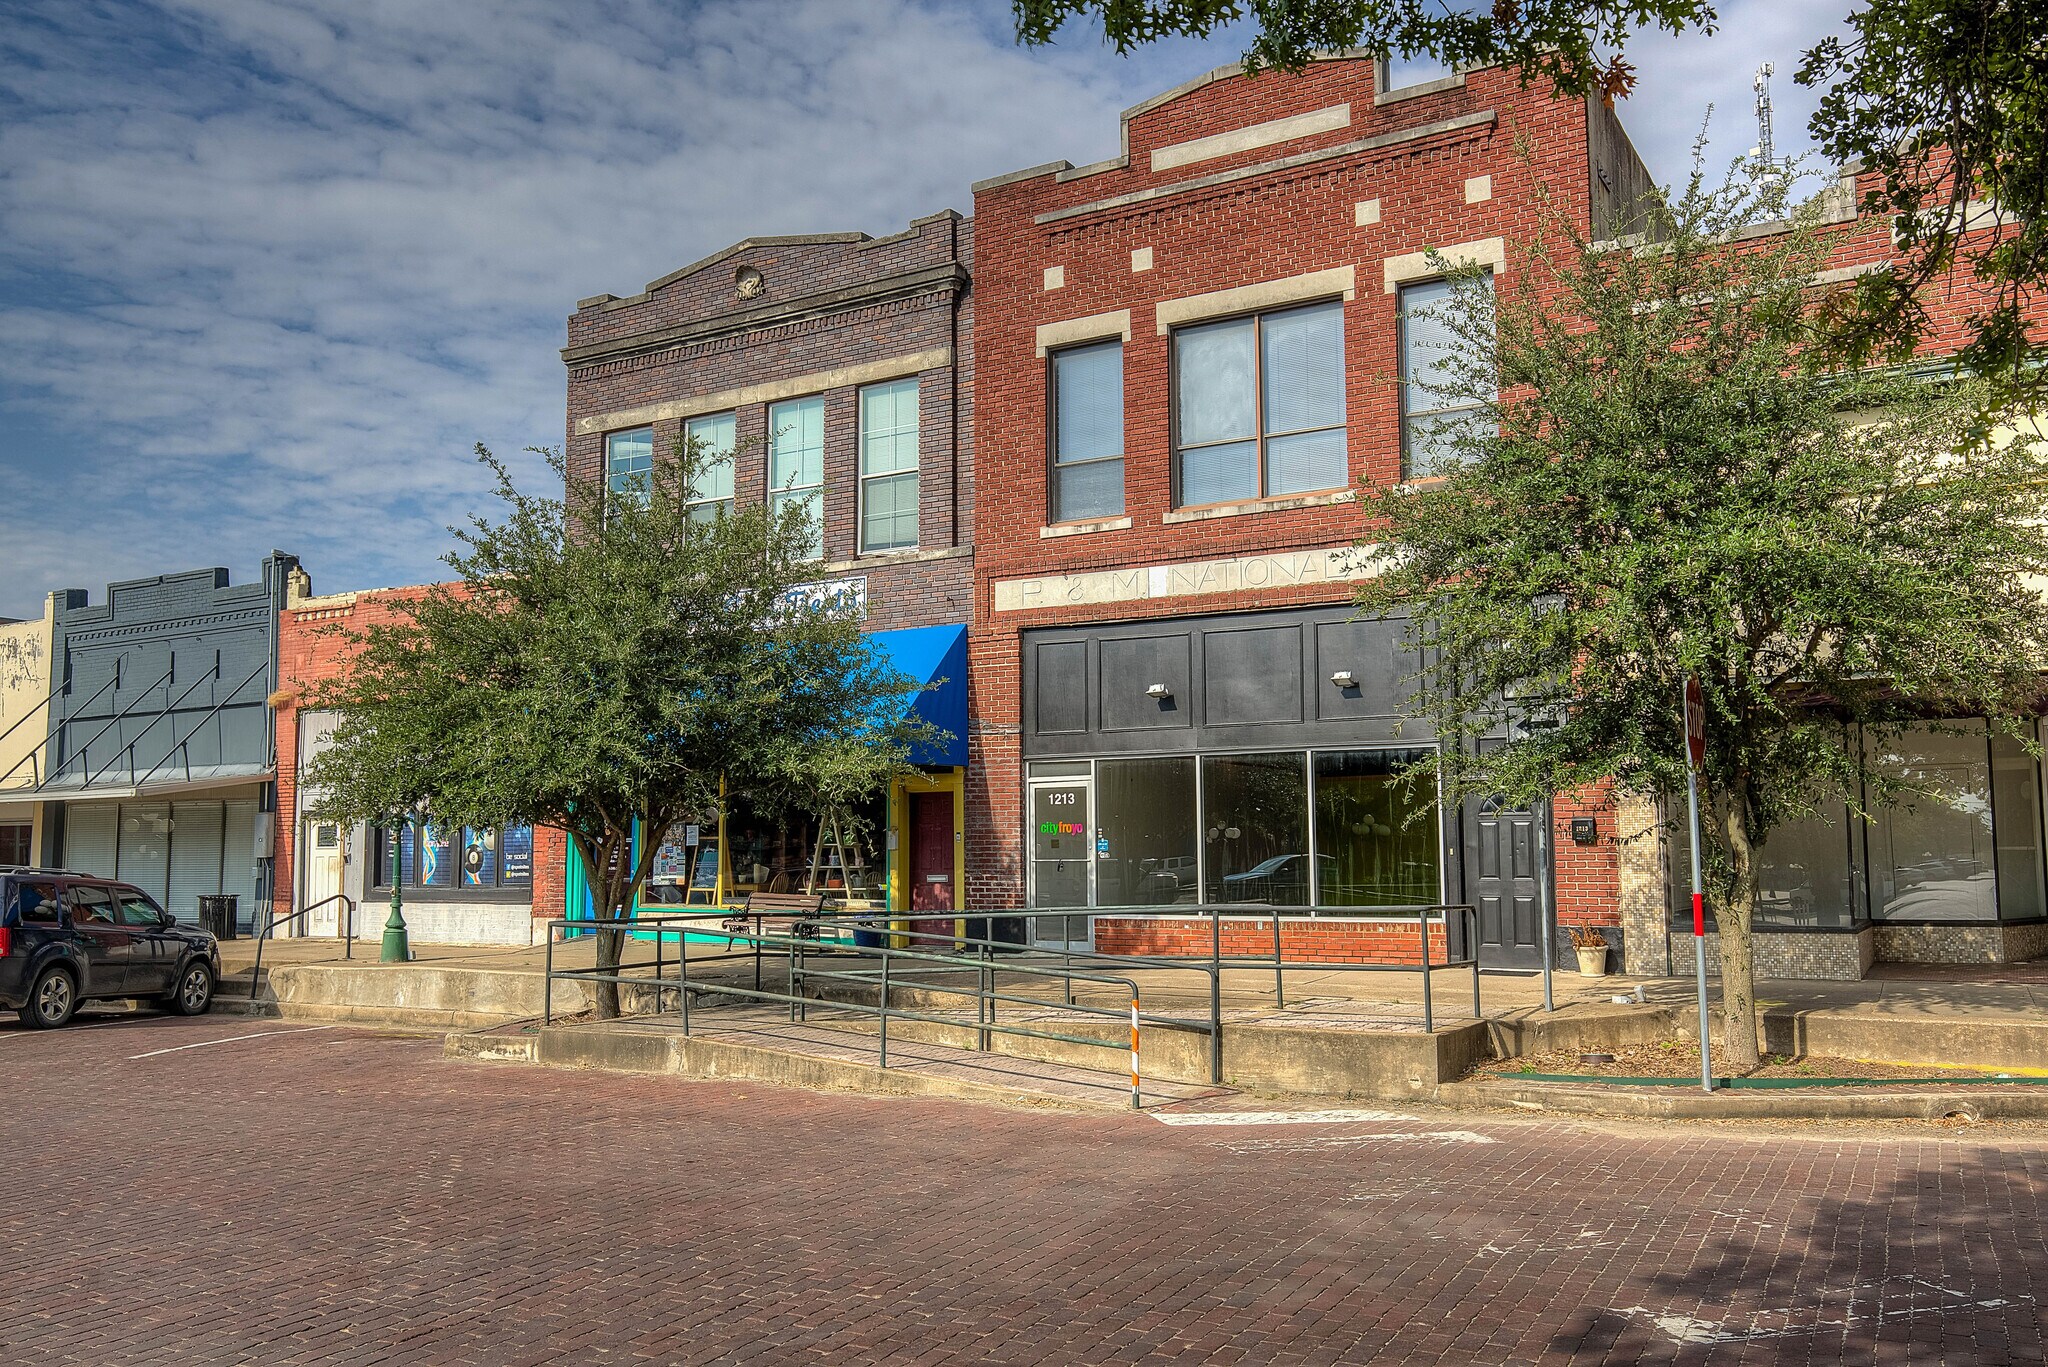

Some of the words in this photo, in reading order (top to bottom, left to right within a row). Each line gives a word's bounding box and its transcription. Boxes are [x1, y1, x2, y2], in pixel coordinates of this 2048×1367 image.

[1067, 576, 1084, 601] &
[1171, 551, 1351, 594] NATIONAL
[1687, 700, 1704, 741] STOP
[1048, 793, 1075, 805] 1213
[1040, 821, 1083, 836] cityfroyo
